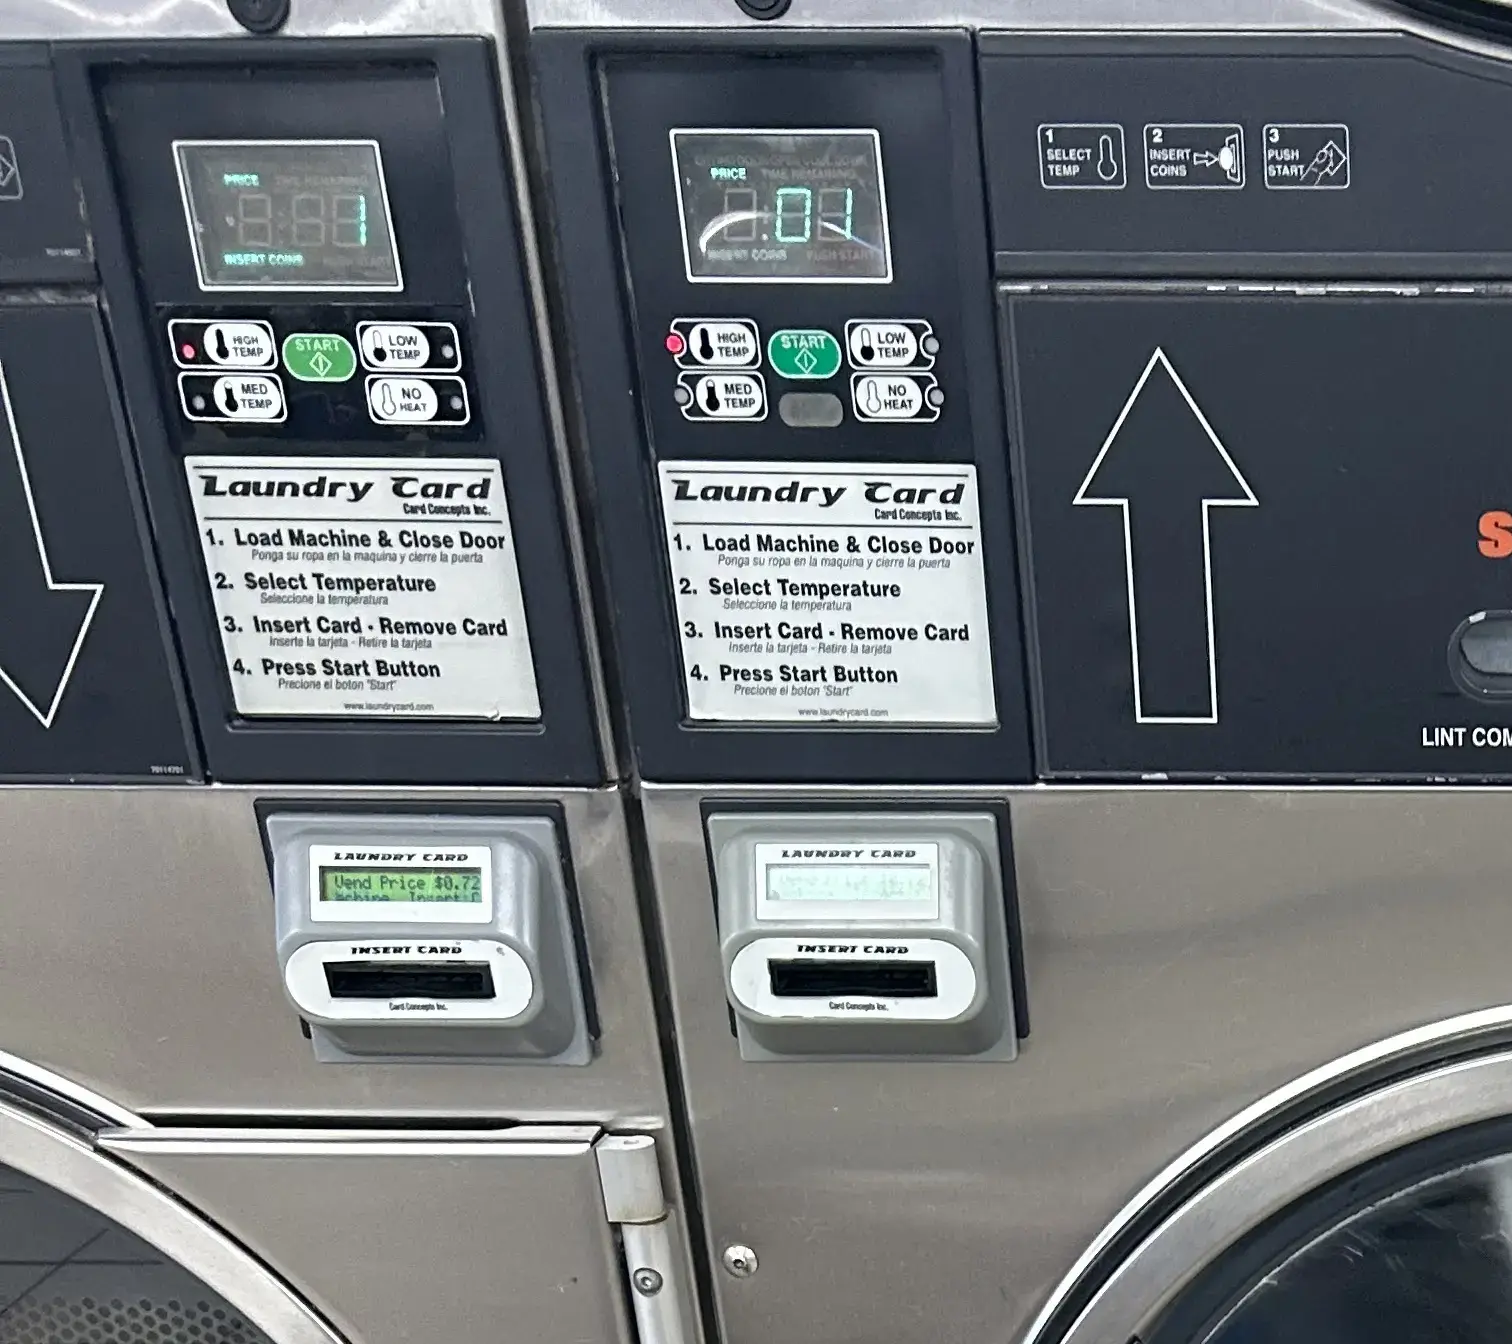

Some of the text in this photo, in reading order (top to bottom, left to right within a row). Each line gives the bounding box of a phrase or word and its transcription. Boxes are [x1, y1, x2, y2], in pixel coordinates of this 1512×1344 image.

[1046, 129, 1053, 143] 1
[1153, 128, 1162, 142] 2
[1270, 129, 1279, 142] 3
[1047, 149, 1091, 160] SELECT
[1150, 149, 1190, 160] INSERT
[1268, 149, 1299, 160] PUSH
[710, 167, 747, 180] PRICE
[1048, 165, 1079, 176] TEMP
[1150, 165, 1186, 176] COINS
[1268, 165, 1306, 178] START
[233, 336, 258, 345] HIGH
[295, 338, 342, 351] START
[717, 333, 746, 343] HIGH
[781, 334, 827, 351] START
[878, 332, 905, 344] LOW
[232, 347, 263, 357] TEMP
[717, 347, 749, 357] TEMP
[877, 347, 909, 358] TEMP
[725, 384, 752, 394] MED
[888, 385, 906, 396] NO
[724, 398, 755, 408] TEMP
[884, 400, 913, 409] HEAT
[199, 475, 491, 502] Laundry Card
[672, 480, 965, 507] Laundry Card
[206, 528, 504, 549] 1. Load Machine & Close Door
[674, 533, 974, 554] 1. Load Machine & Close Door
[718, 555, 750, 568] Ponga
[752, 557, 765, 567] su
[767, 557, 791, 569] ropa
[794, 557, 806, 567] en
[809, 555, 818, 567] la
[820, 556, 864, 570] maquina
[866, 559, 873, 570] y
[907, 556, 916, 569] la
[918, 557, 951, 570] puerta
[215, 572, 436, 594] 2. Select Temperature
[680, 578, 900, 600] 2. Select Temperature
[723, 598, 852, 612] Seleccione la temperatura
[224, 616, 243, 632] 3.
[253, 616, 311, 633] Insert
[317, 616, 362, 633] Card
[379, 617, 456, 635] Remove
[463, 618, 507, 636] Card
[685, 621, 703, 638] 3.
[715, 622, 771, 639] Insert
[778, 622, 823, 639] Card
[841, 623, 918, 640] Remove
[925, 624, 969, 641] Card
[233, 658, 440, 677] 4. Press Start Button
[690, 665, 897, 682] 4. Press Start Button
[1423, 728, 1466, 746] LINT
[335, 853, 416, 861] LAUNDRY
[334, 875, 481, 890] Vend Price $0.72
[798, 945, 908, 954] INSERT CARD
